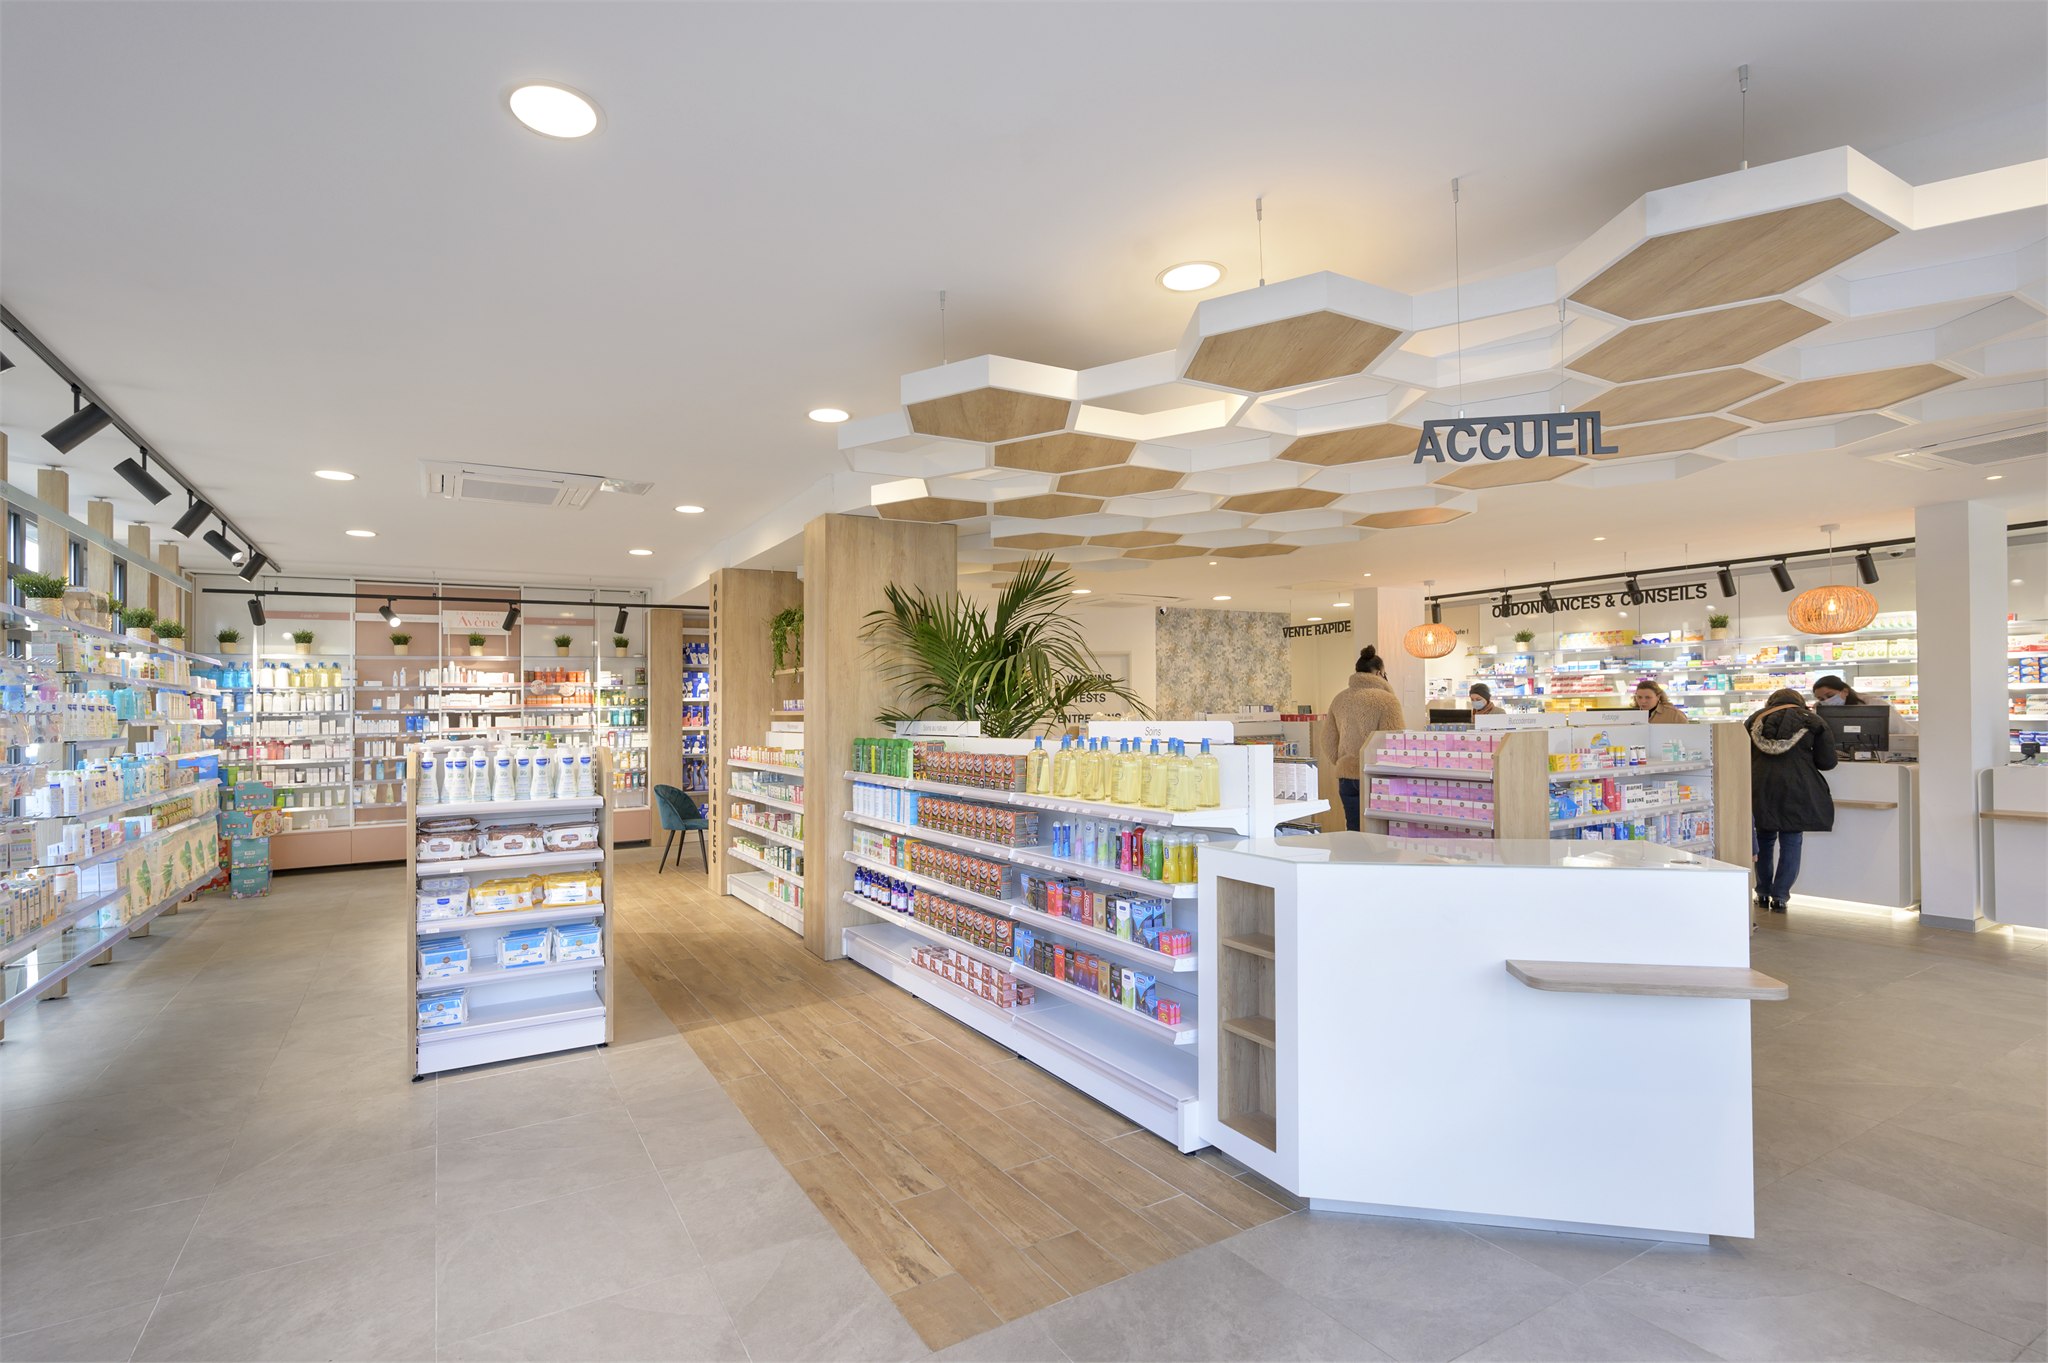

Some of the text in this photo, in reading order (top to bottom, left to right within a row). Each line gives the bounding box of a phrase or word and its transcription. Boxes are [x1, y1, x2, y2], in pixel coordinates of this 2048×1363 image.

[1413, 411, 1619, 464] ACCUEIL
[1492, 595, 1600, 618] ODONNNCES
[1605, 594, 1616, 608] &
[459, 615, 499, 628] Avène
[1282, 620, 1351, 638] VENTE RAPIDE
[1145, 726, 1161, 736] Soins
